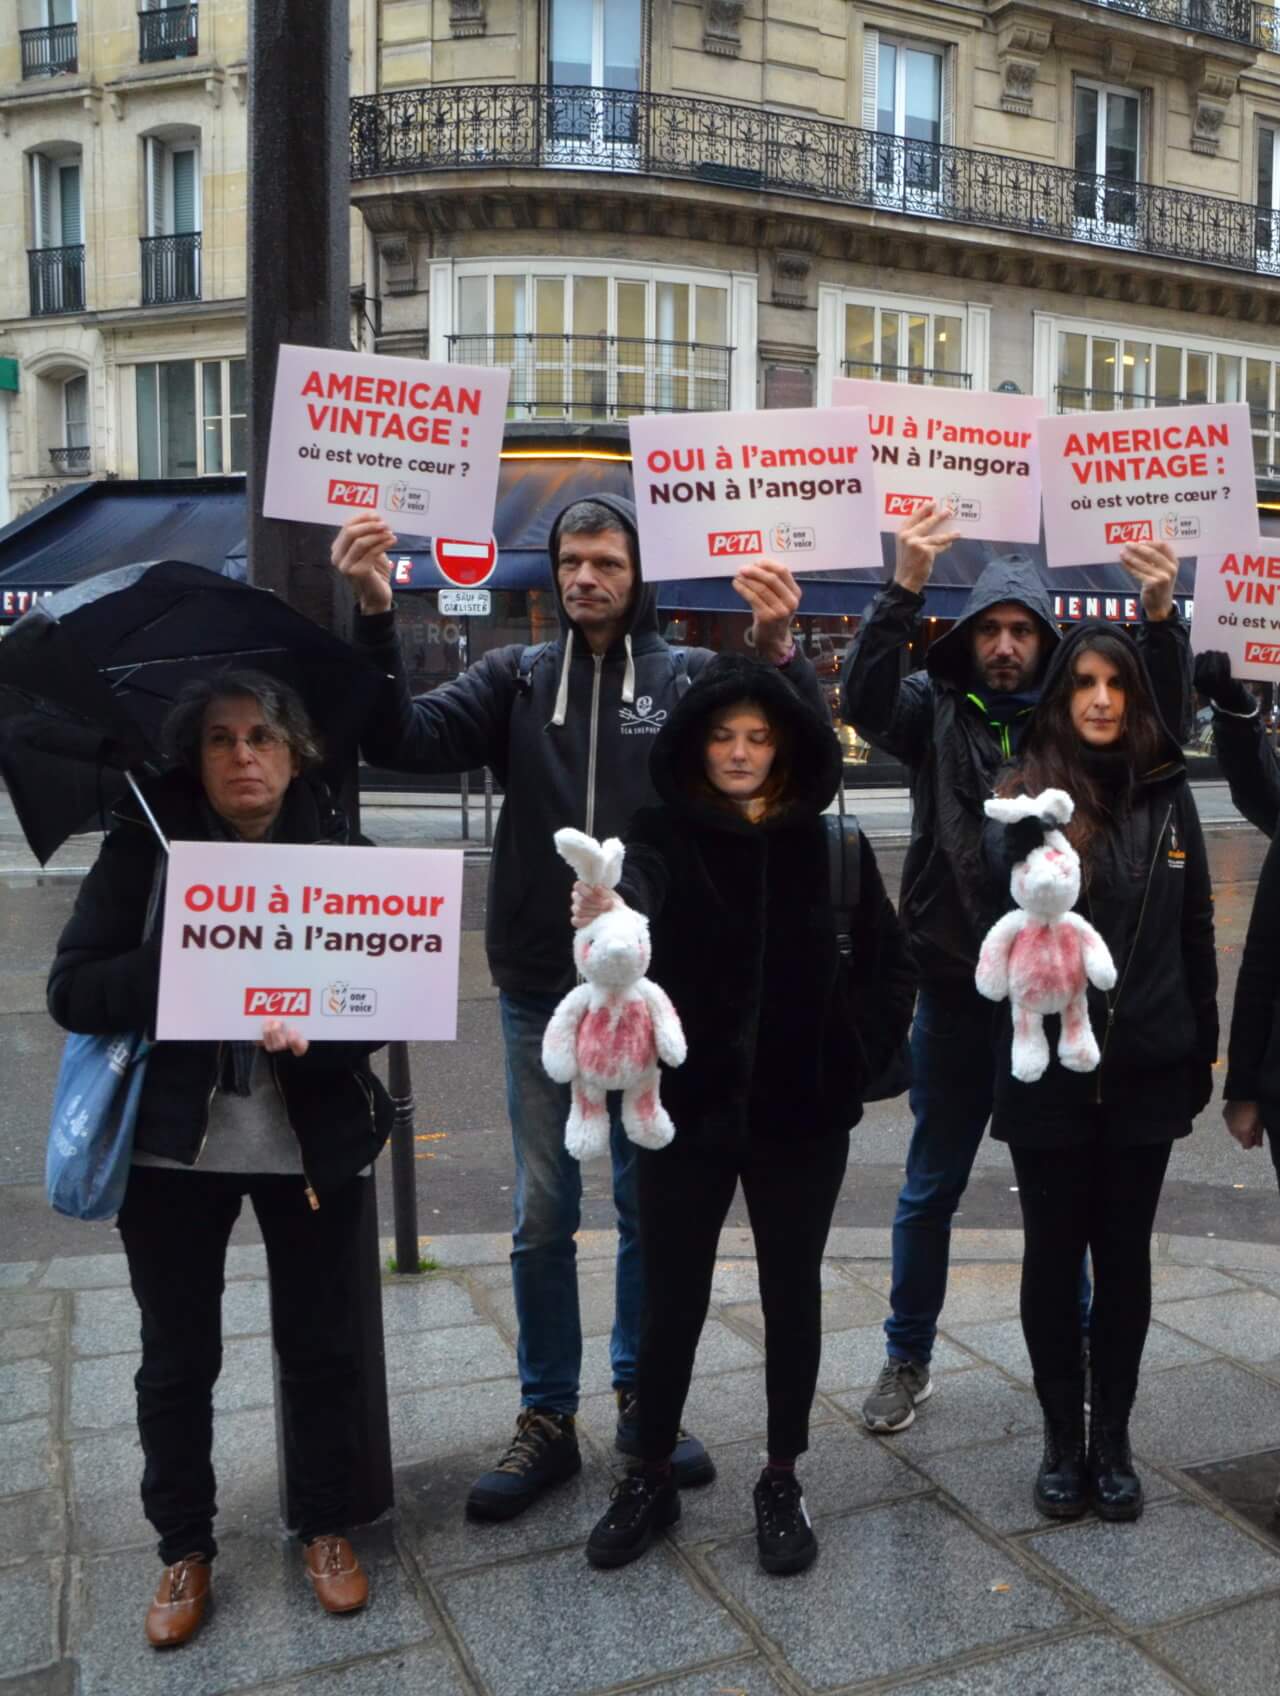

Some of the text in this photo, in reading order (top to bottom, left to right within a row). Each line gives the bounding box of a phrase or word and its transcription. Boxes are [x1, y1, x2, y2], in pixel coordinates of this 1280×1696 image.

[301, 371, 481, 415] AMERICAN
[307, 403, 452, 446] VINTAGE
[868, 414, 1032, 448] UI à l’amour
[1063, 423, 1229, 457] AMERICAN
[298, 444, 319, 460] où
[326, 448, 352, 463] est
[357, 452, 402, 469] votre
[408, 458, 455, 475] cœur
[647, 448, 705, 473] OUI
[715, 446, 732, 470] à
[742, 445, 858, 469] l’amour
[907, 446, 921, 467] à
[929, 449, 1030, 476] l’angora
[1071, 453, 1208, 485] VINTAGE
[650, 478, 862, 504] NON à l’angora
[1071, 497, 1092, 510] où
[1097, 494, 1122, 508] est
[1126, 492, 1169, 506] votre
[1175, 489, 1217, 502] cœur
[3, 592, 54, 615] ETI
[1218, 613, 1237, 626] où
[1242, 615, 1266, 628] est
[184, 884, 444, 917] OUI à l’amour
[182, 924, 442, 956] NON à l’angora
[350, 993, 366, 1001] one
[350, 1002, 372, 1012] voice
